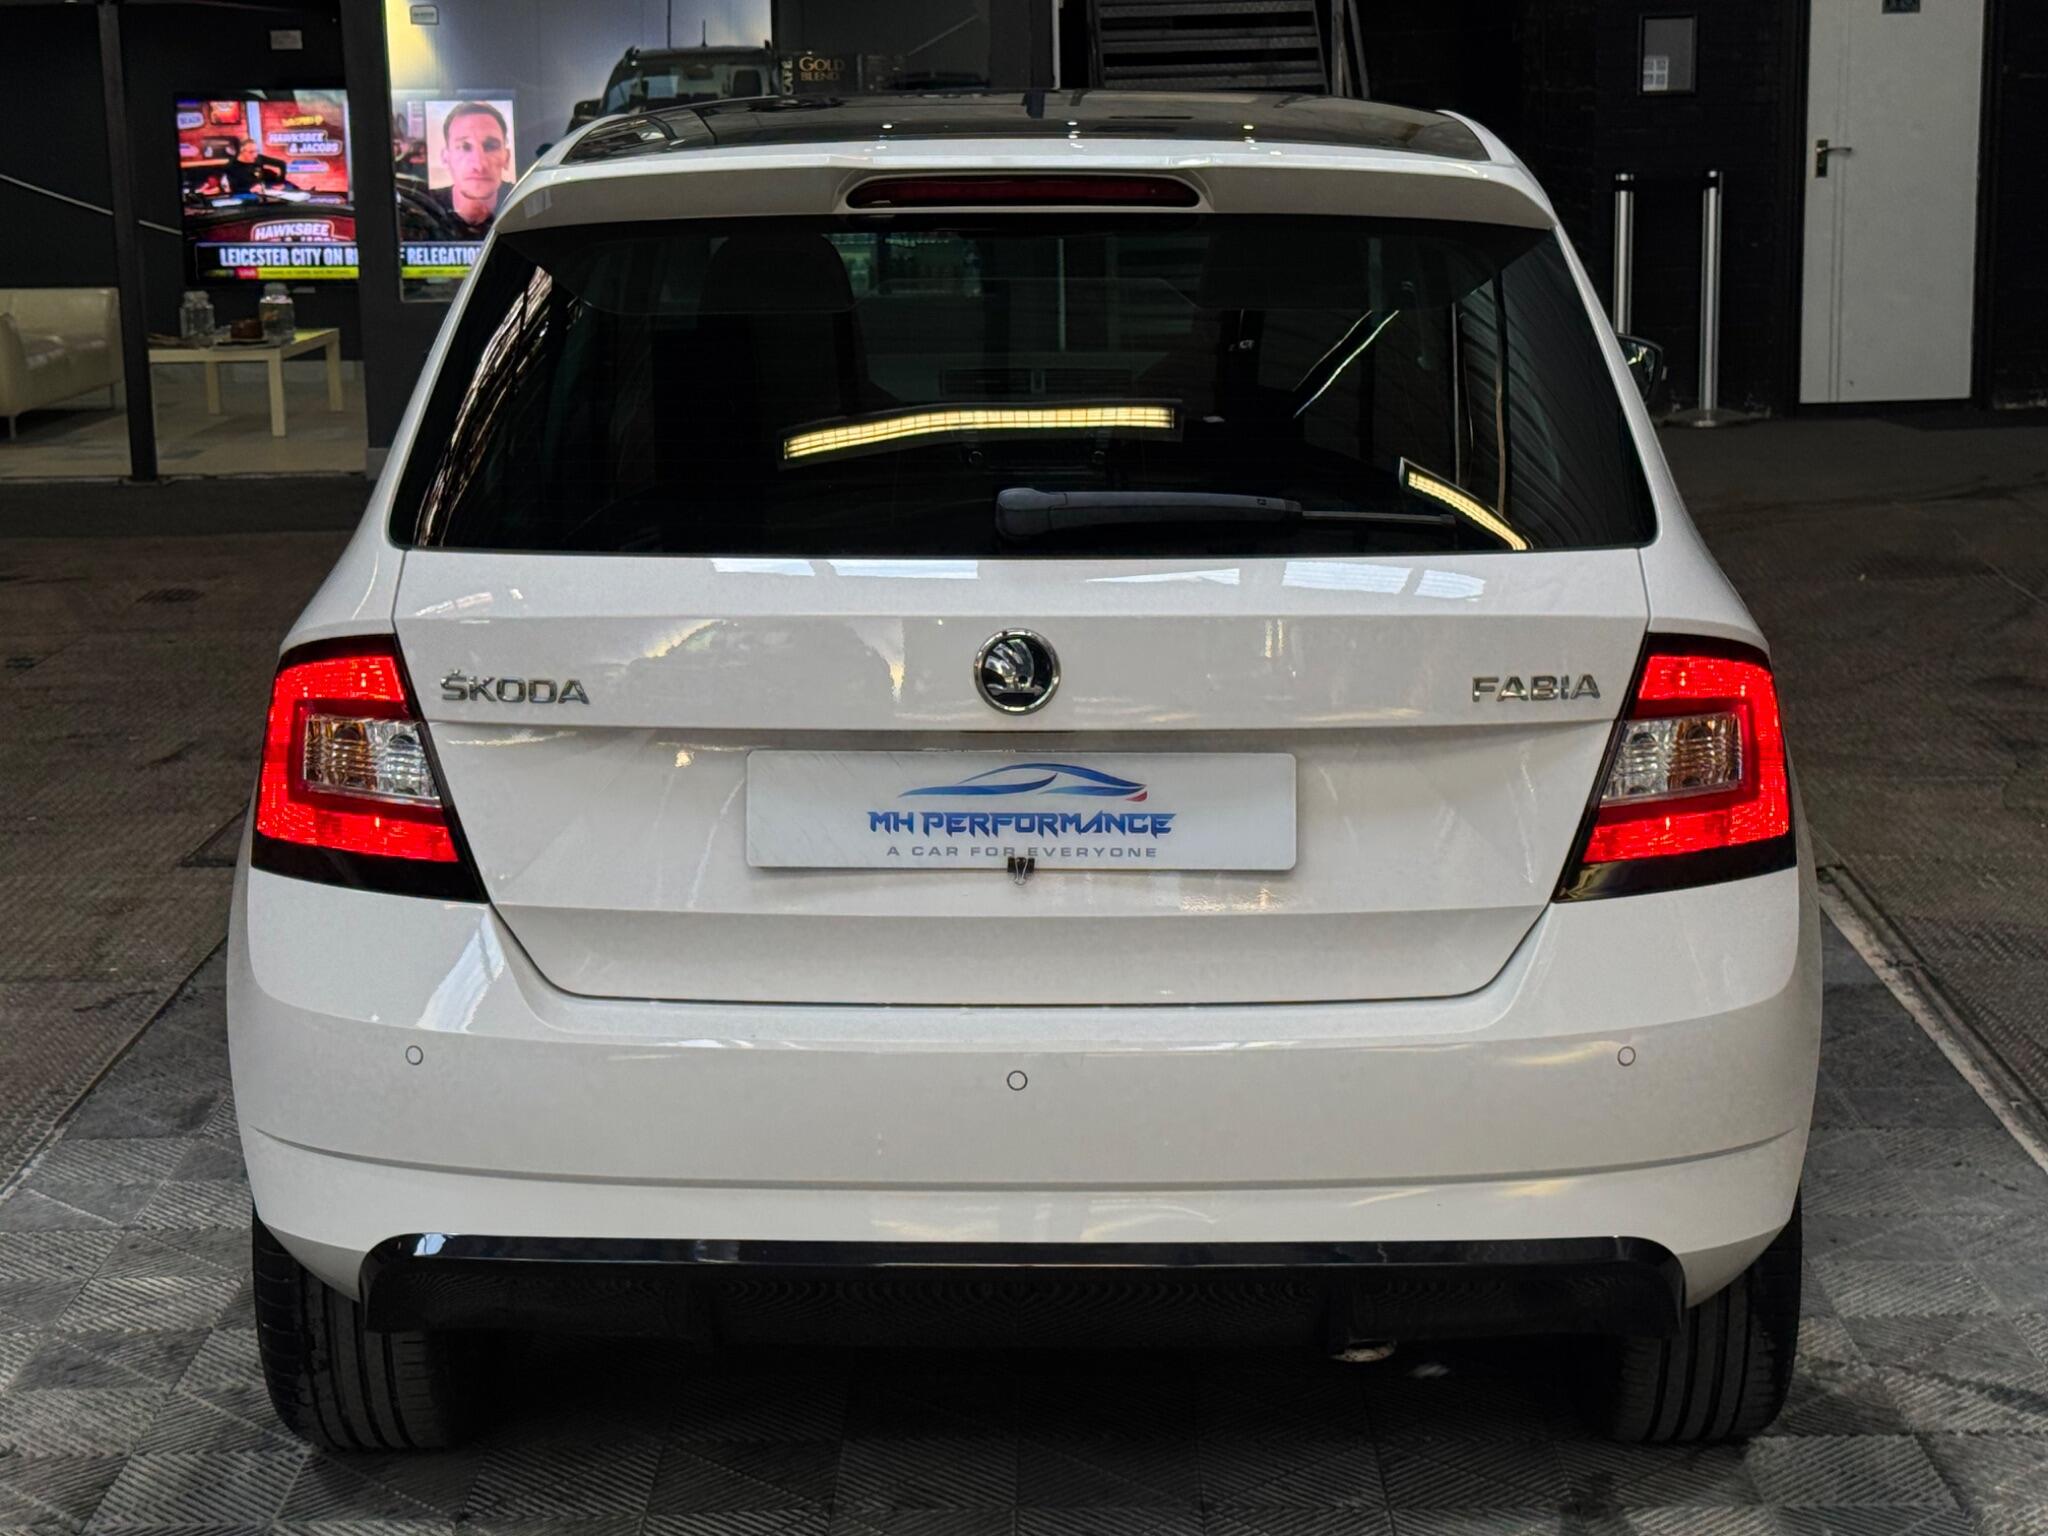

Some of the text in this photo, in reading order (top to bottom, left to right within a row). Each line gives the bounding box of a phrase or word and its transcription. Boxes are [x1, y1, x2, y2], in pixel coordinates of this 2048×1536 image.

[219, 247, 289, 267] LEICESTER
[291, 247, 321, 266] CITY
[323, 247, 343, 266] ON
[440, 669, 590, 705] ŠKODA
[1472, 674, 1601, 702] FABIA
[867, 810, 1177, 839] MH PERFORMANCE
[886, 846, 1157, 858] A CAR FOR EVERYONE
